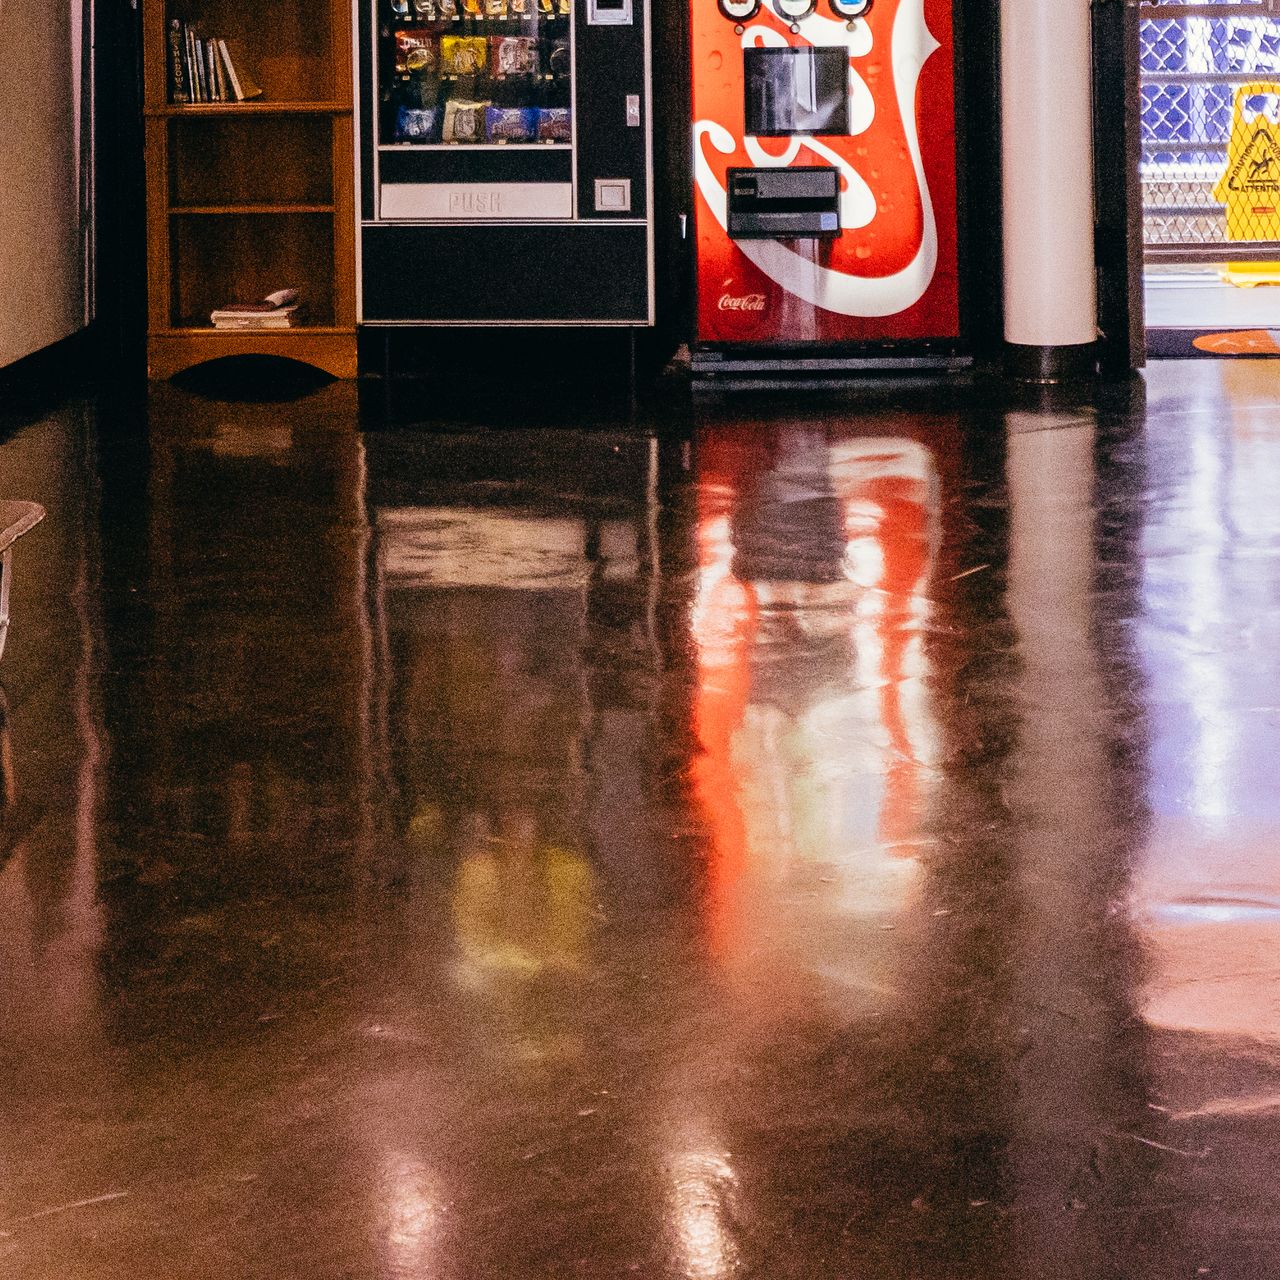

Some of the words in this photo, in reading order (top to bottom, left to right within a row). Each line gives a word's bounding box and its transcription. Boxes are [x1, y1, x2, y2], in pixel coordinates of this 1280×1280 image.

[1233, 142, 1255, 176] CAUTION
[449, 192, 505, 212] PUSH
[718, 294, 766, 311] Coca-Cola
